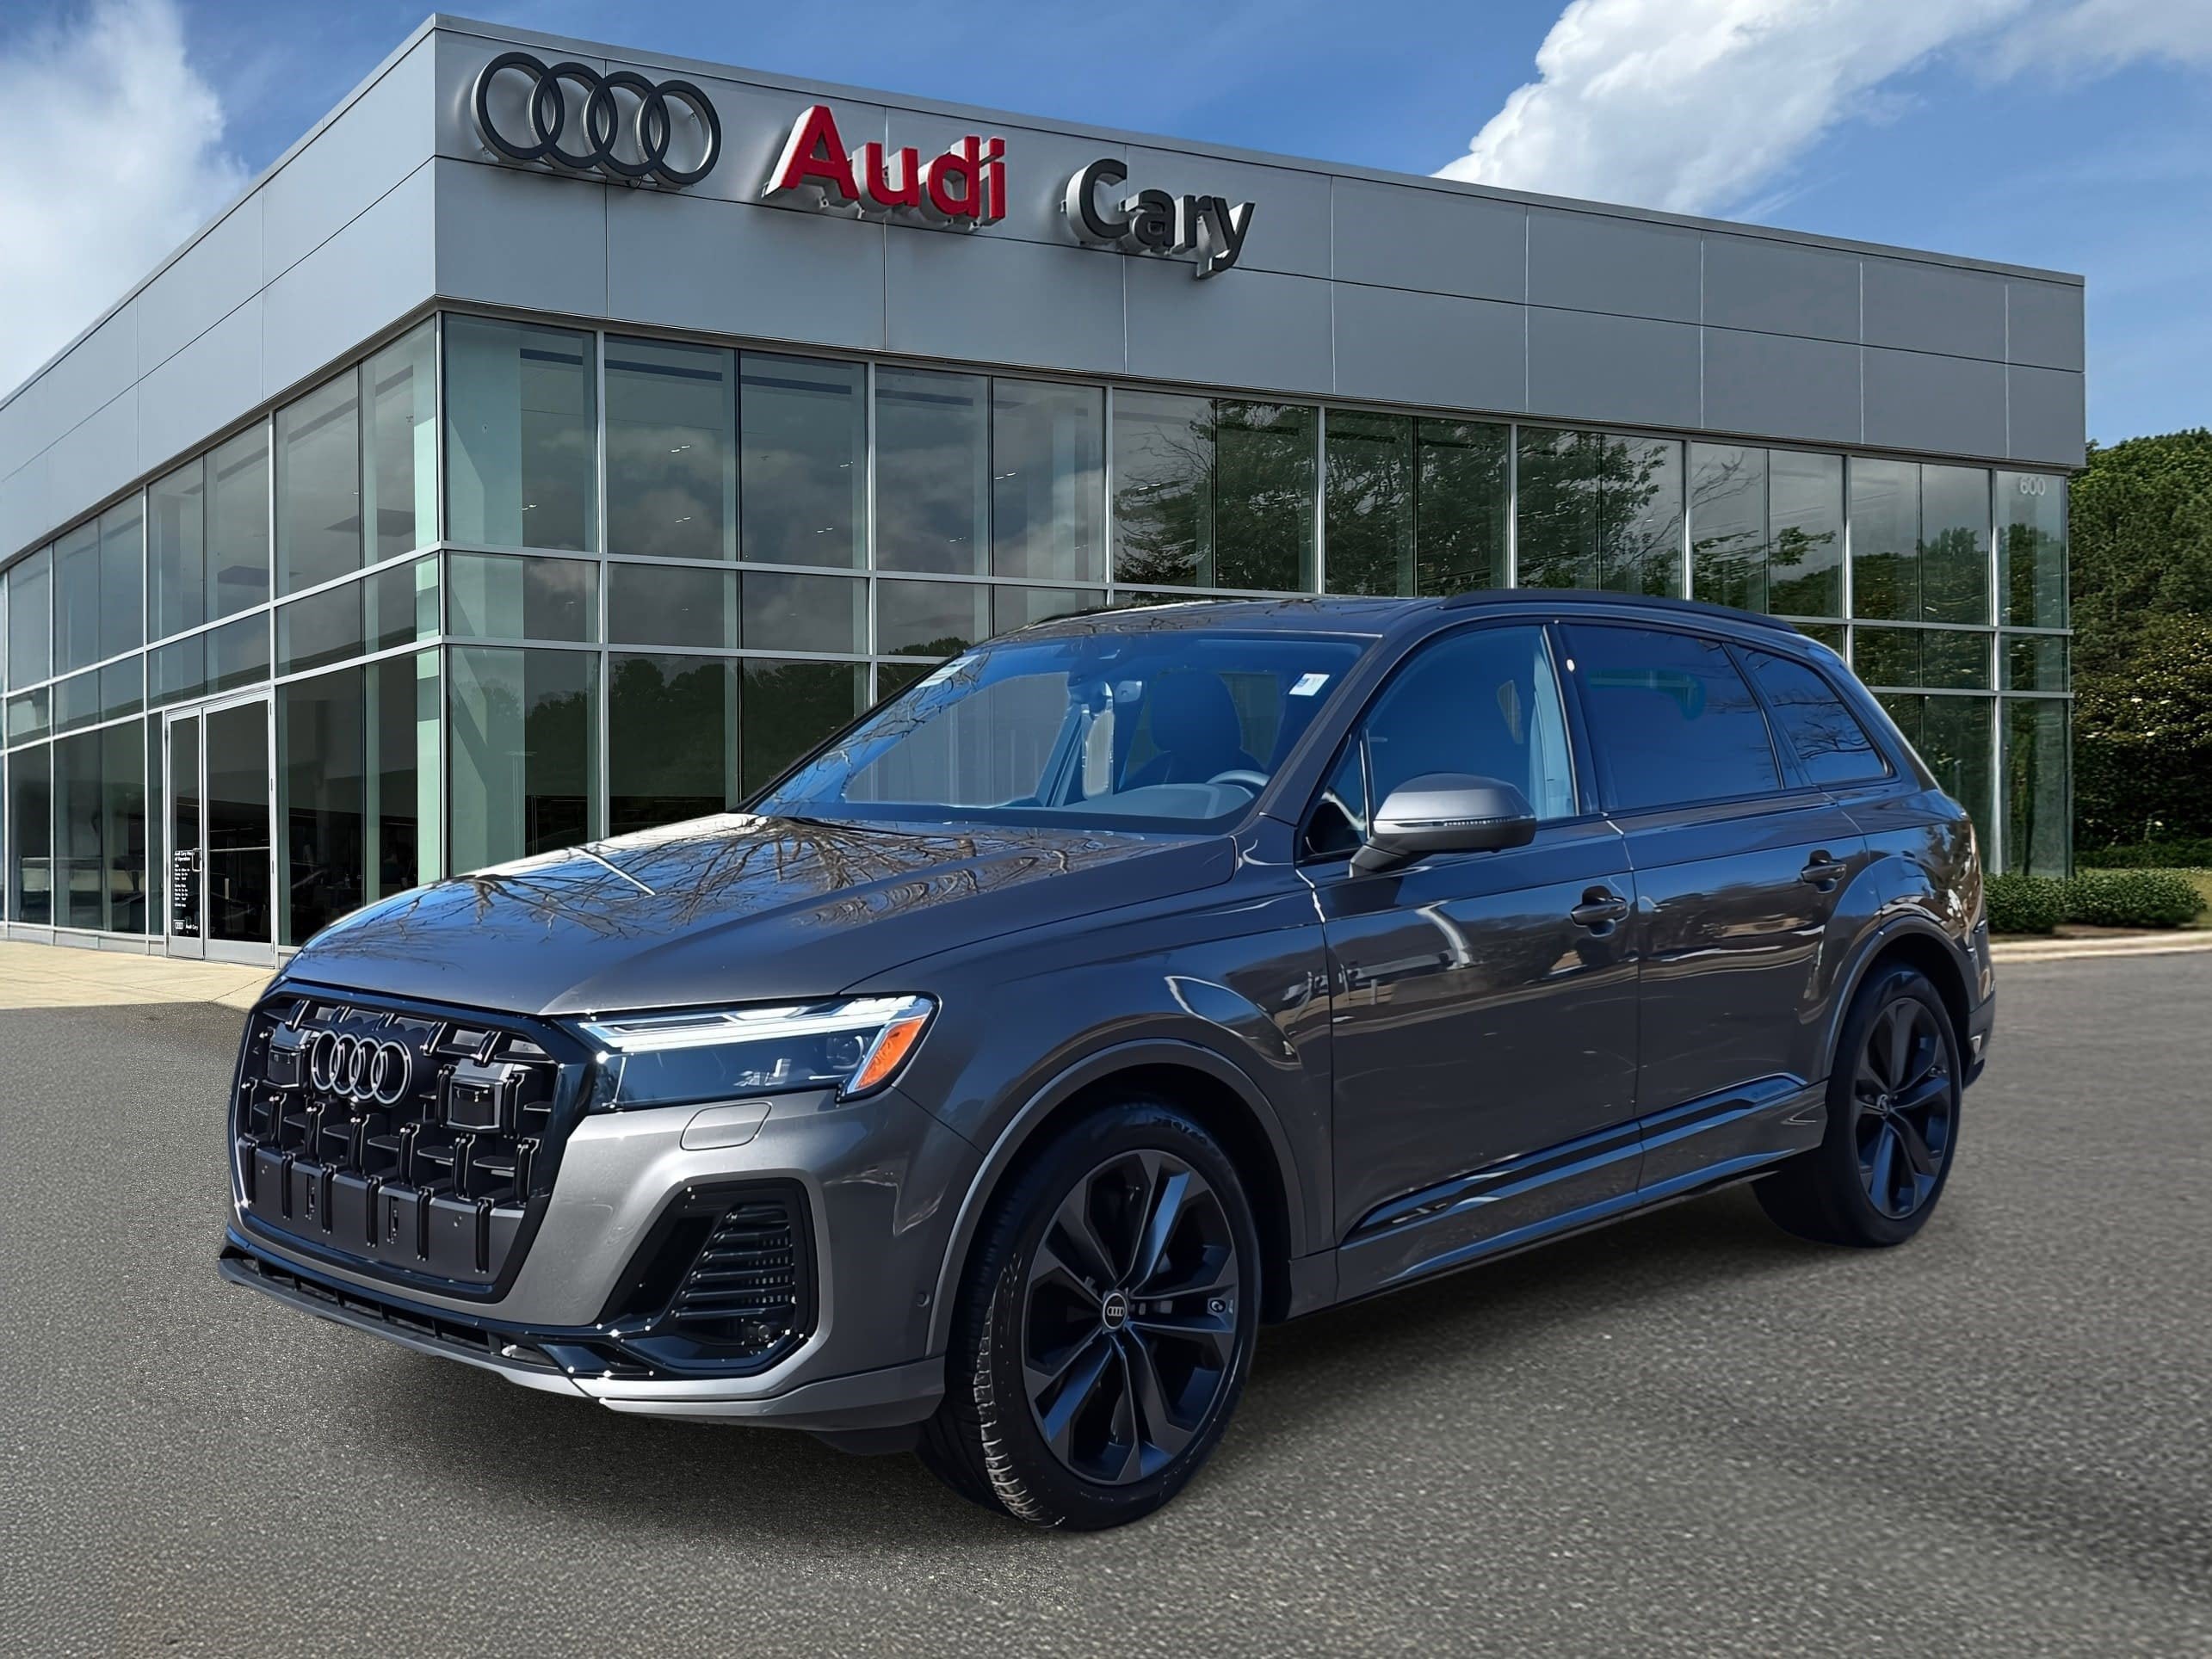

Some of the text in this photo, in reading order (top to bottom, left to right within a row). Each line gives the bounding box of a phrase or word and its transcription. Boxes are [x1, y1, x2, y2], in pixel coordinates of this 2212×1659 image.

[773, 104, 1256, 274] Audi Cary
[2019, 477, 2045, 496] 600
